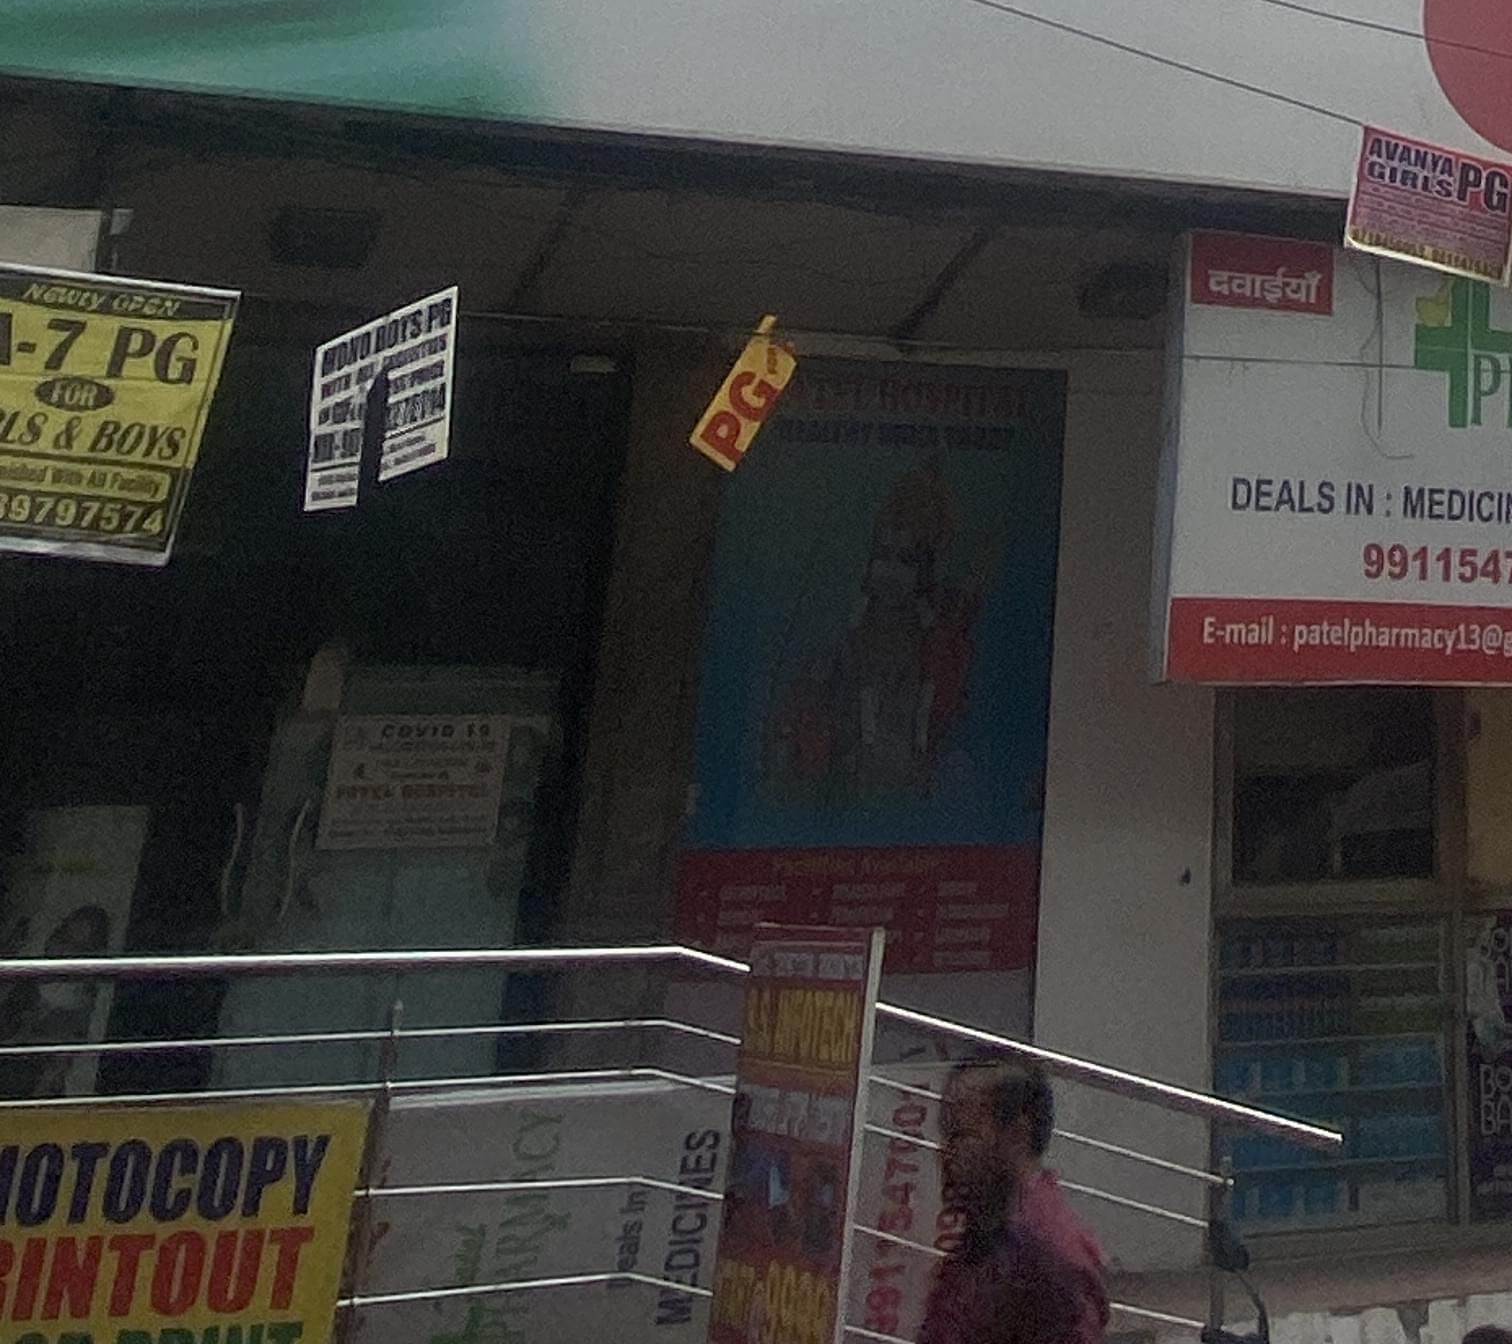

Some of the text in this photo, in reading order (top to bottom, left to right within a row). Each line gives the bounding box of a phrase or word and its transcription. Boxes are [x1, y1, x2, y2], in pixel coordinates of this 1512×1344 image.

[1366, 159, 1453, 200] GIRLS
[1368, 136, 1510, 214] AVANYA PG
[22, 283, 182, 317] NEWLY OPEN
[1206, 267, 1324, 304] दवाईयाँ
[105, 324, 200, 386] PG
[49, 383, 99, 407] FOR
[700, 370, 781, 464] PG
[53, 415, 188, 462] & BOYS
[1231, 476, 1336, 515] DEALS
[1346, 481, 1375, 517] IN
[1202, 616, 1274, 646] E-mail
[655, 1126, 723, 1327] MEDICINES
